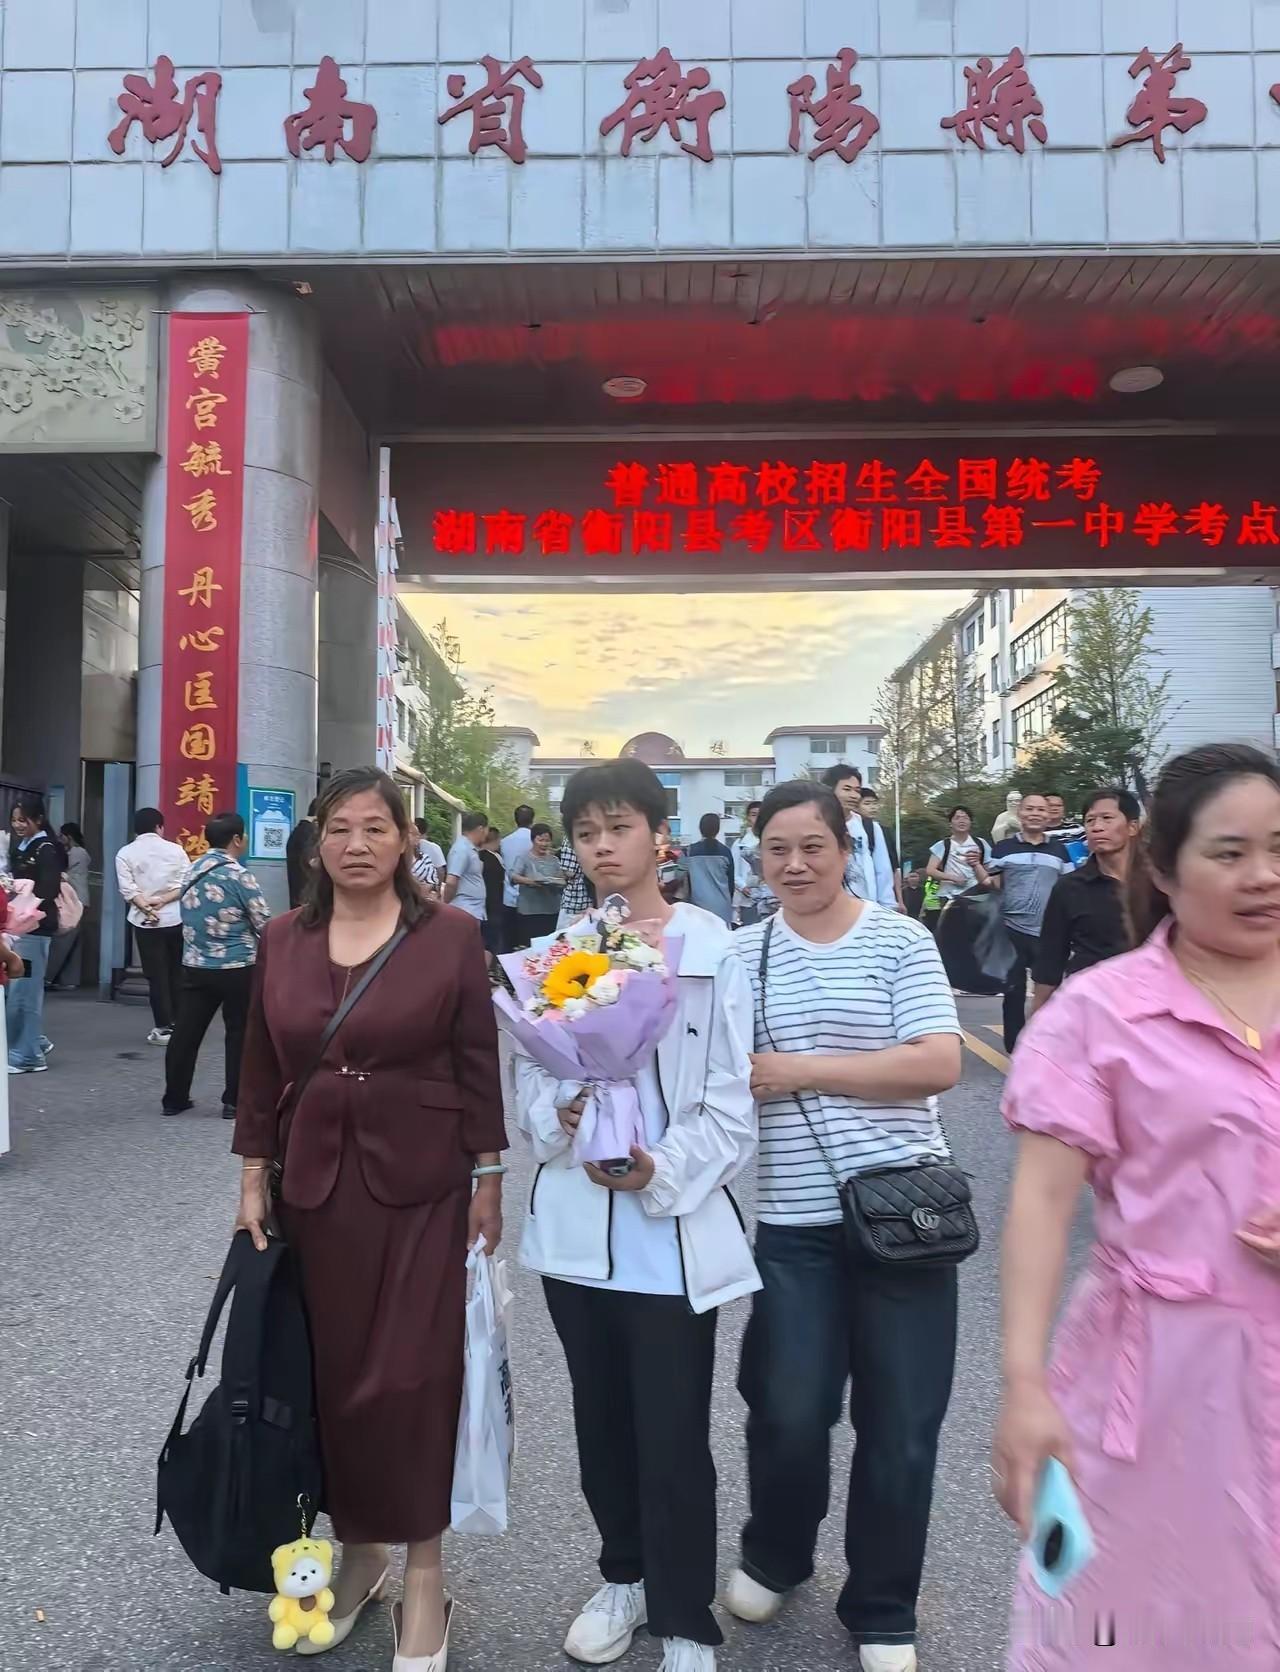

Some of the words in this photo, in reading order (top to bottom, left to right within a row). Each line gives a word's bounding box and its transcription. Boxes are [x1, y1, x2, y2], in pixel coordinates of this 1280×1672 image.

[108, 46, 1280, 173] 湖南省衡陽縣第
[604, 457, 1103, 507] 普通高校招生全国统考
[432, 501, 1280, 556] 湖南省衡阳县考区衡阳县第一中学考点
